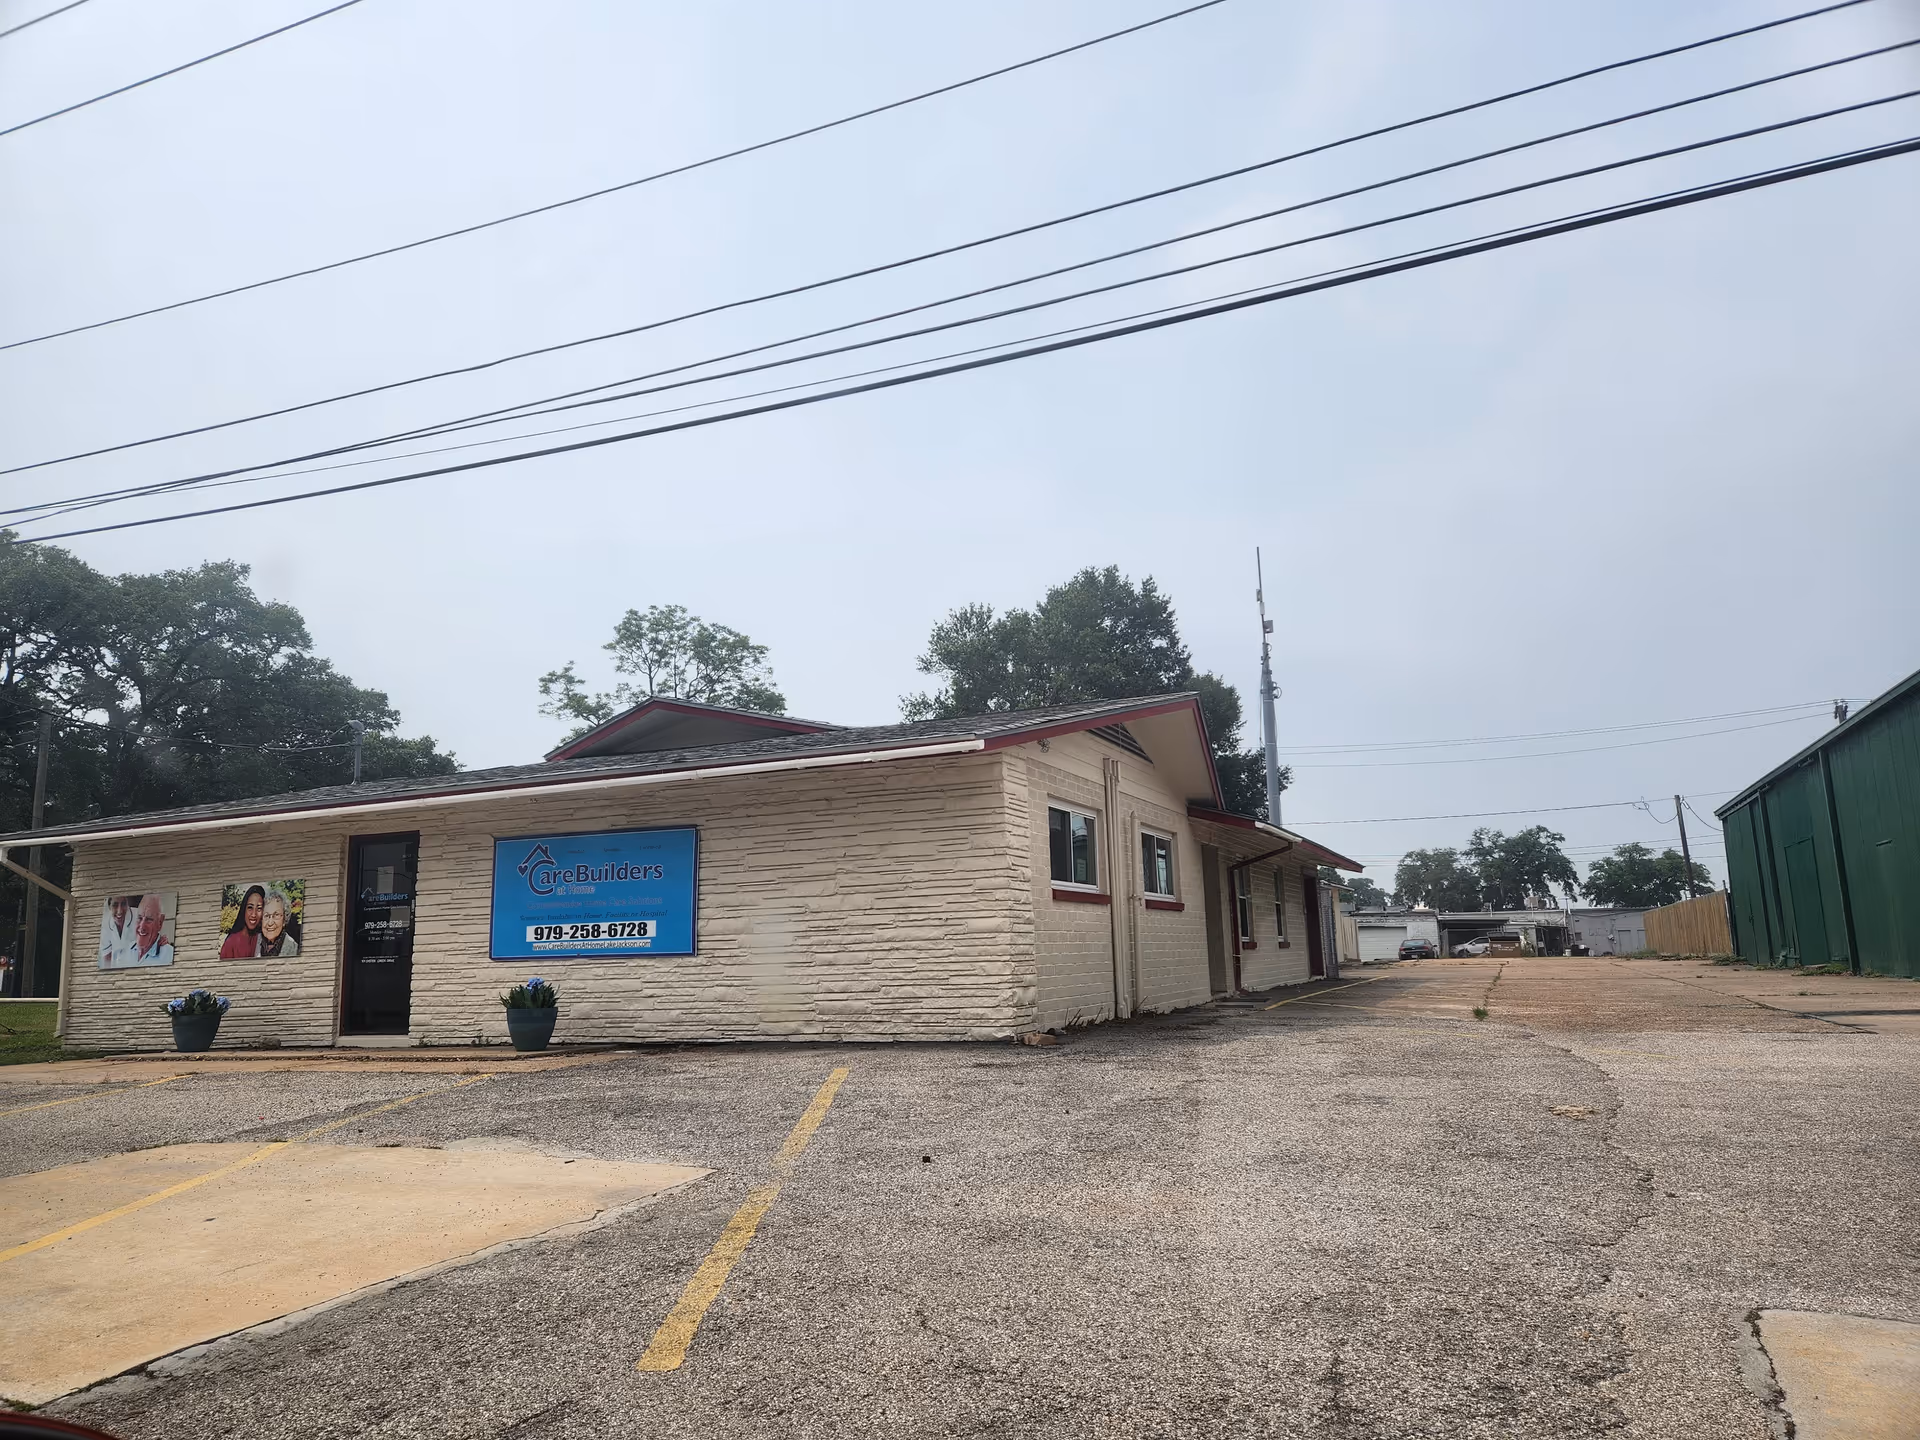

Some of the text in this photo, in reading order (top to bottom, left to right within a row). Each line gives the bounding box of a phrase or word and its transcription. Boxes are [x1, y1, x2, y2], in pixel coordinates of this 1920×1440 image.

[528, 859, 664, 896] CareBuilders
[556, 884, 596, 896] at Home
[639, 909, 668, 918] Hospital
[364, 920, 403, 930] 979-258-6728
[534, 921, 648, 941] 979-258-6728
